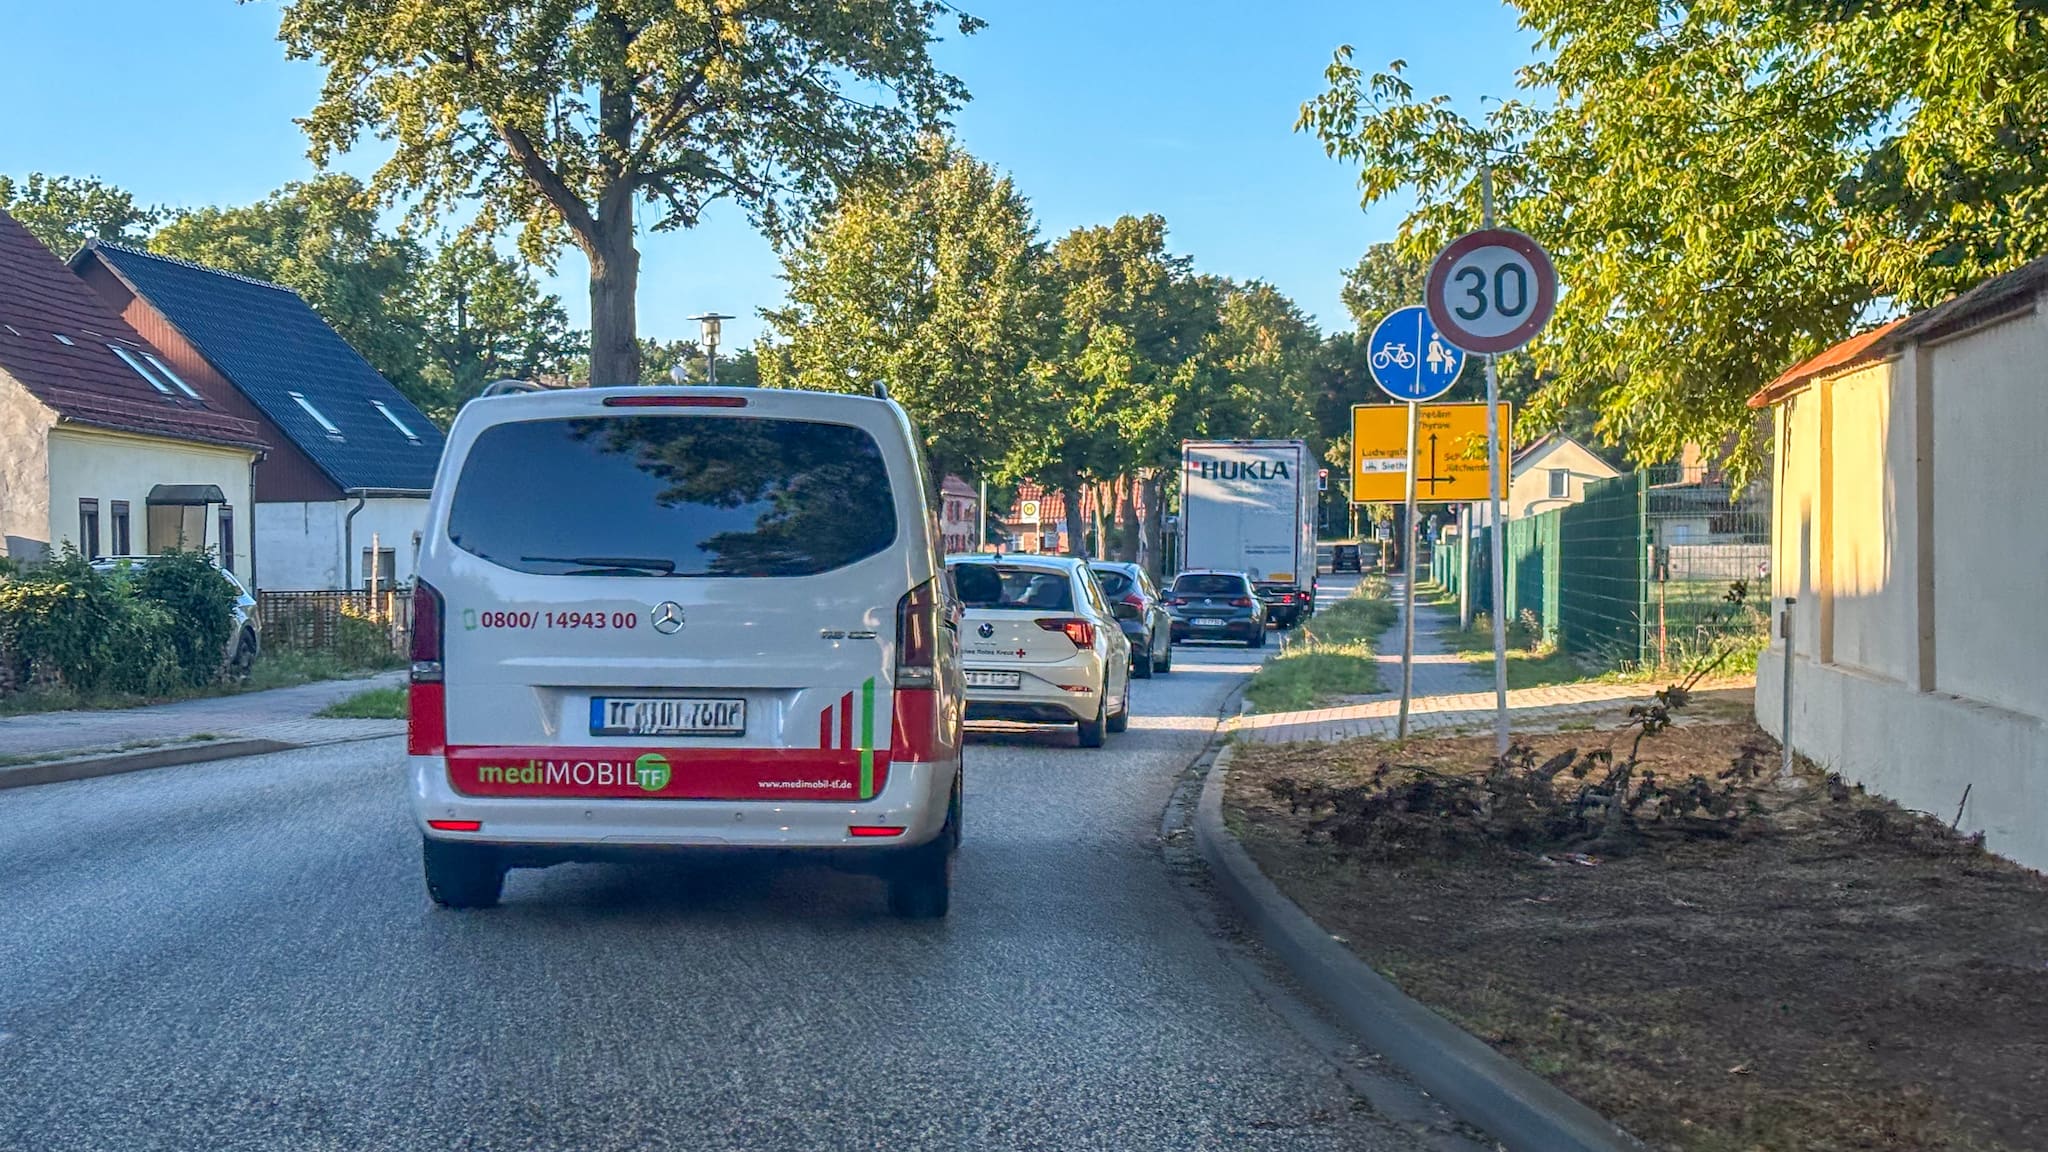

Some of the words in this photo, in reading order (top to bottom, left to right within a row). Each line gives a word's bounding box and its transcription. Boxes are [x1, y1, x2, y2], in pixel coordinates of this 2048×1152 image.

[1455, 262, 1528, 321] 30
[1201, 460, 1290, 480] HUKLA
[481, 611, 539, 629] 0800/
[545, 612, 606, 629] 14943
[612, 612, 637, 629] 00
[758, 779, 853, 790] www.medimobil-tf.de
